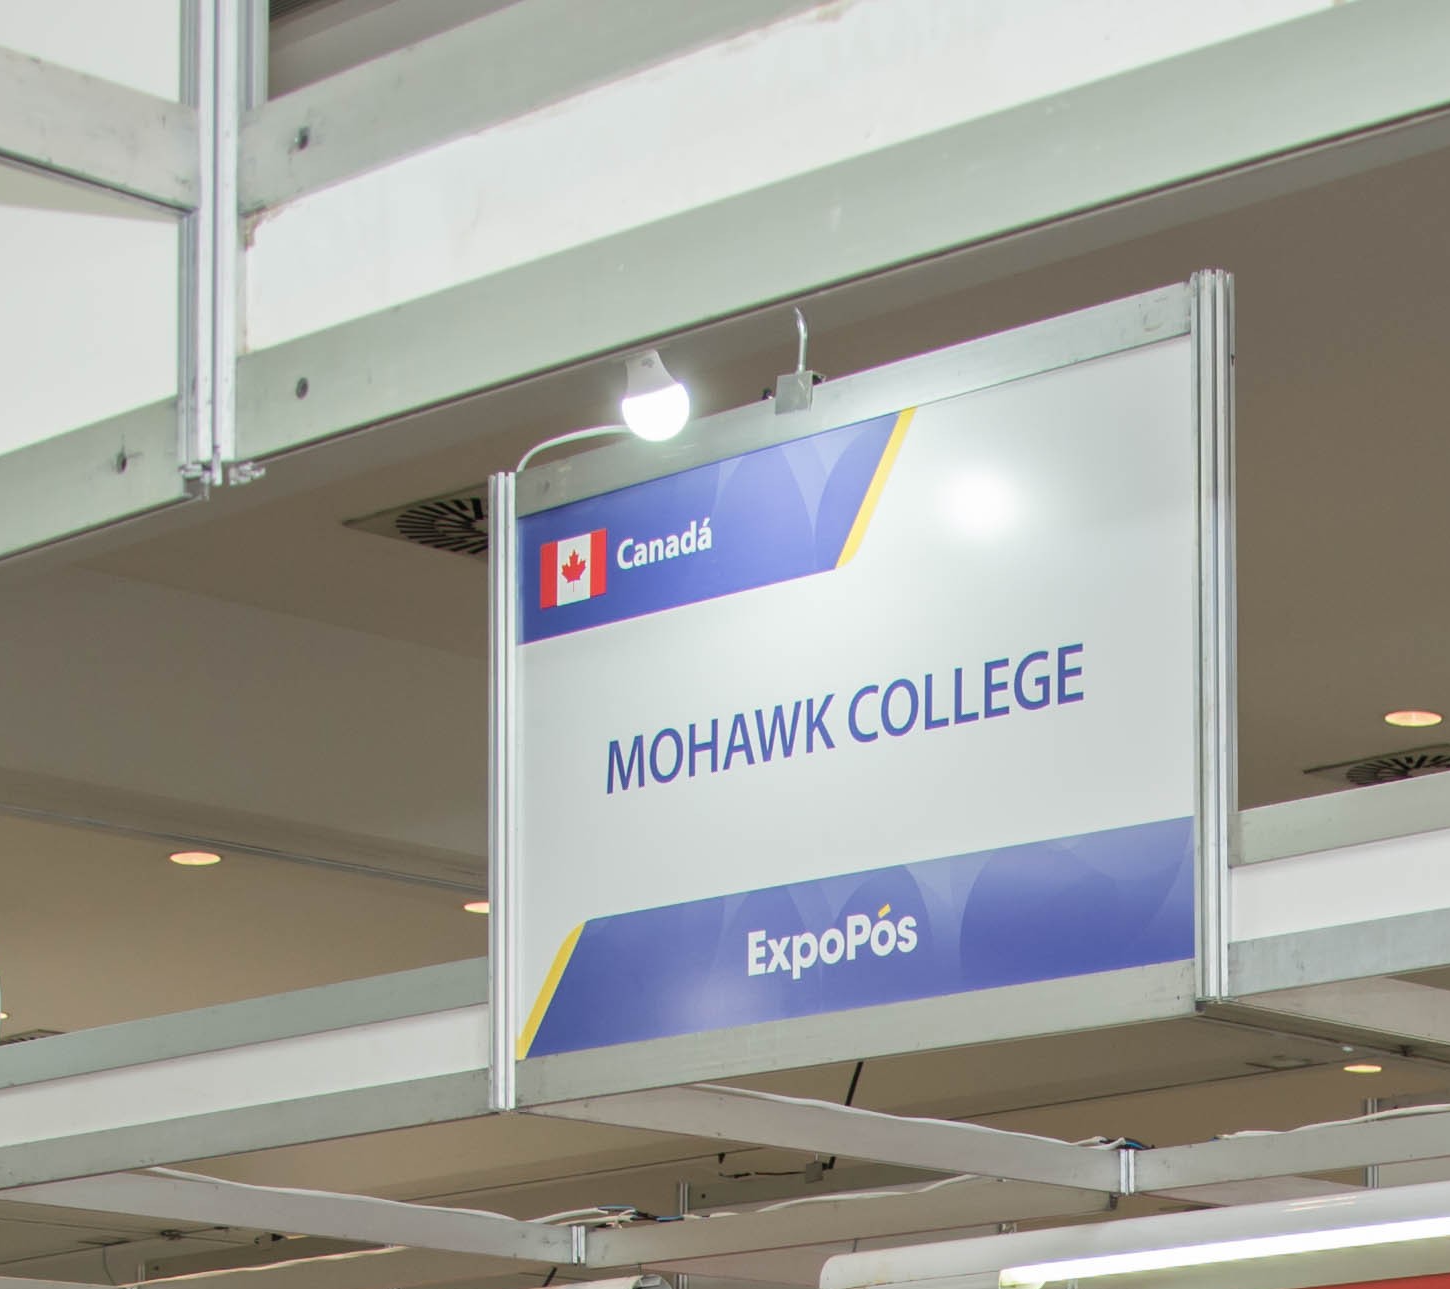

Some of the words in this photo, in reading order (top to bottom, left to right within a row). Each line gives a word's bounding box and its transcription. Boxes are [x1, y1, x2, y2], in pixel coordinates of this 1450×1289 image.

[617, 518, 713, 571] Canadá
[606, 694, 837, 795] MOHAWK
[847, 642, 1086, 745] COLLEGE
[747, 904, 919, 981] ExpoPós
